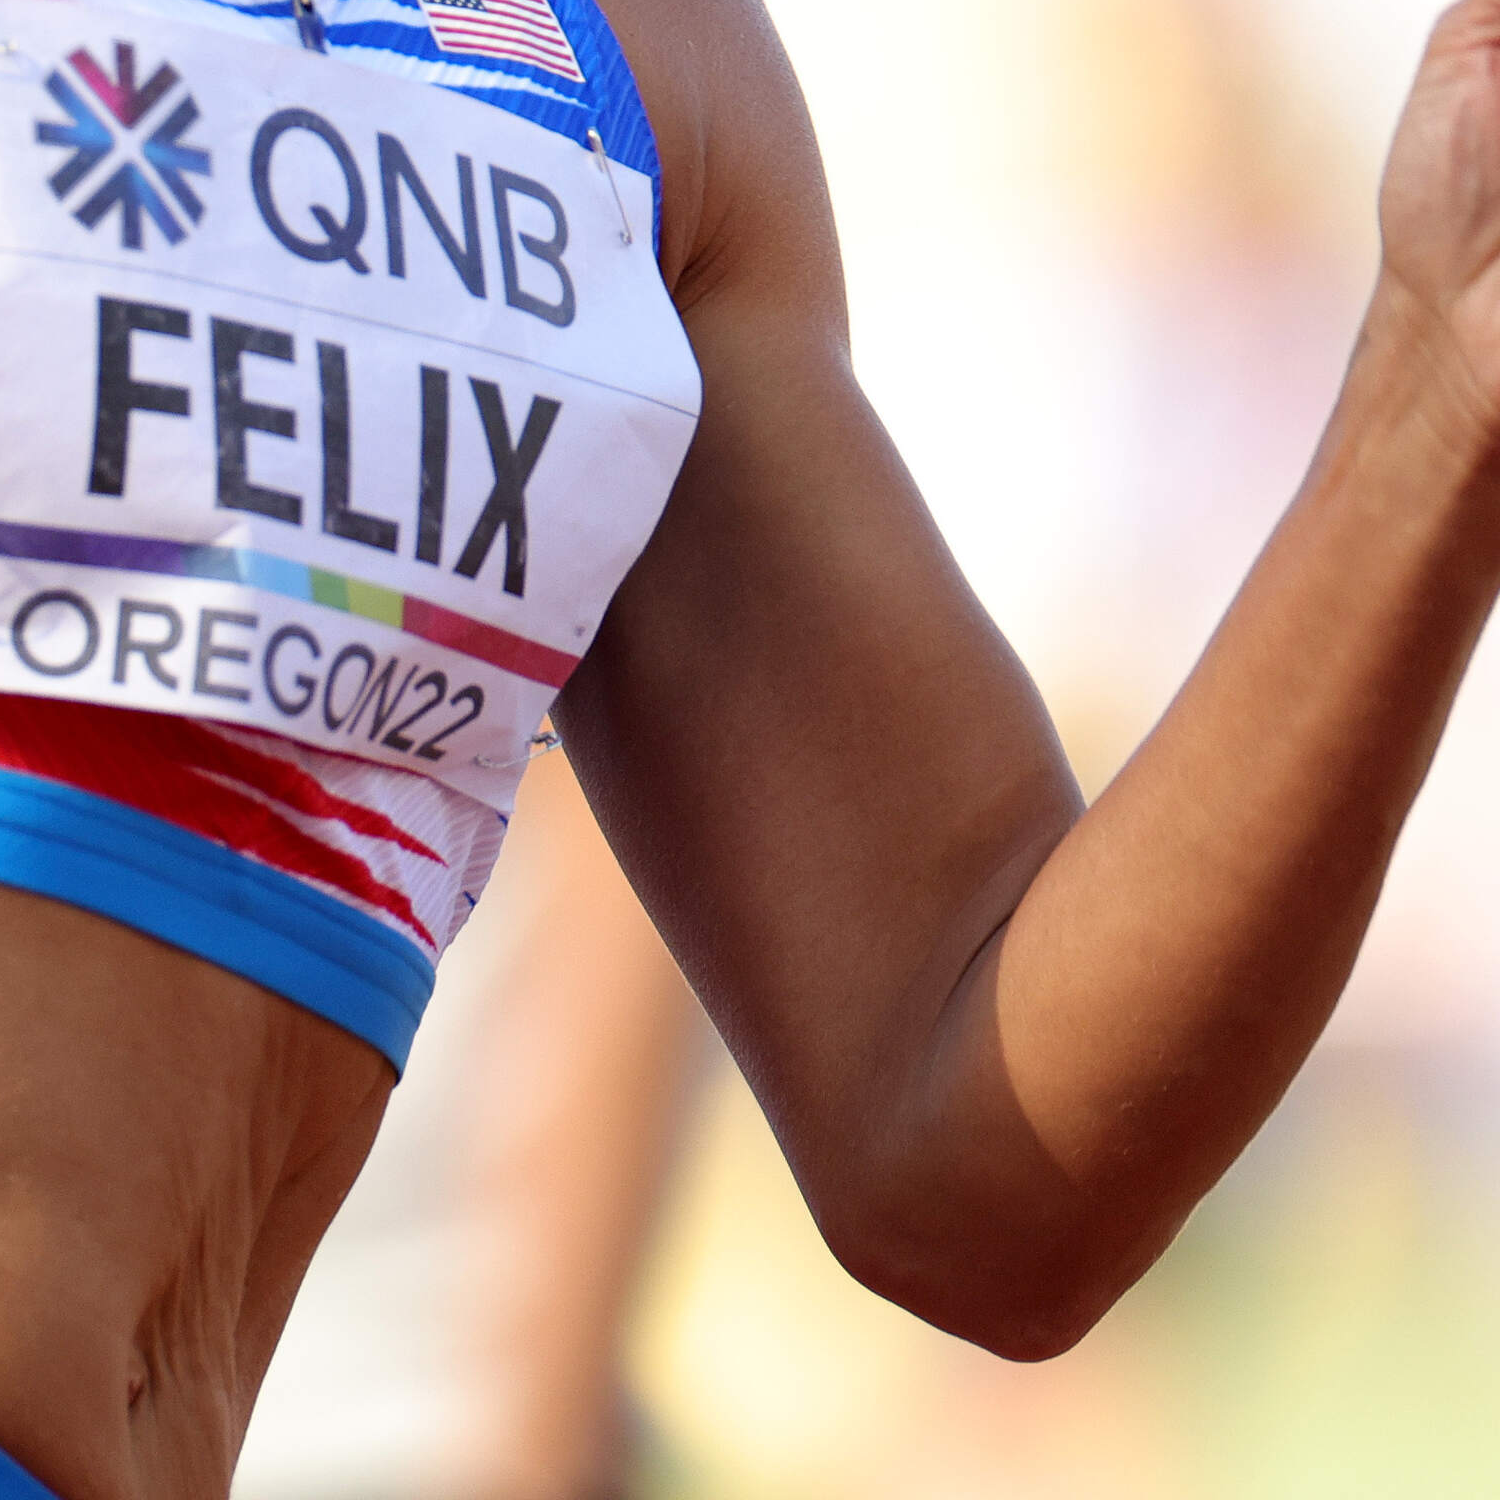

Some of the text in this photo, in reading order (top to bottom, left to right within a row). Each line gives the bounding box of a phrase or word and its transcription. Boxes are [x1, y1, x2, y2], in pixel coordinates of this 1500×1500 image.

[250, 107, 577, 327] QNB
[87, 294, 563, 598] FELIX
[11, 589, 485, 763] OREGON22
